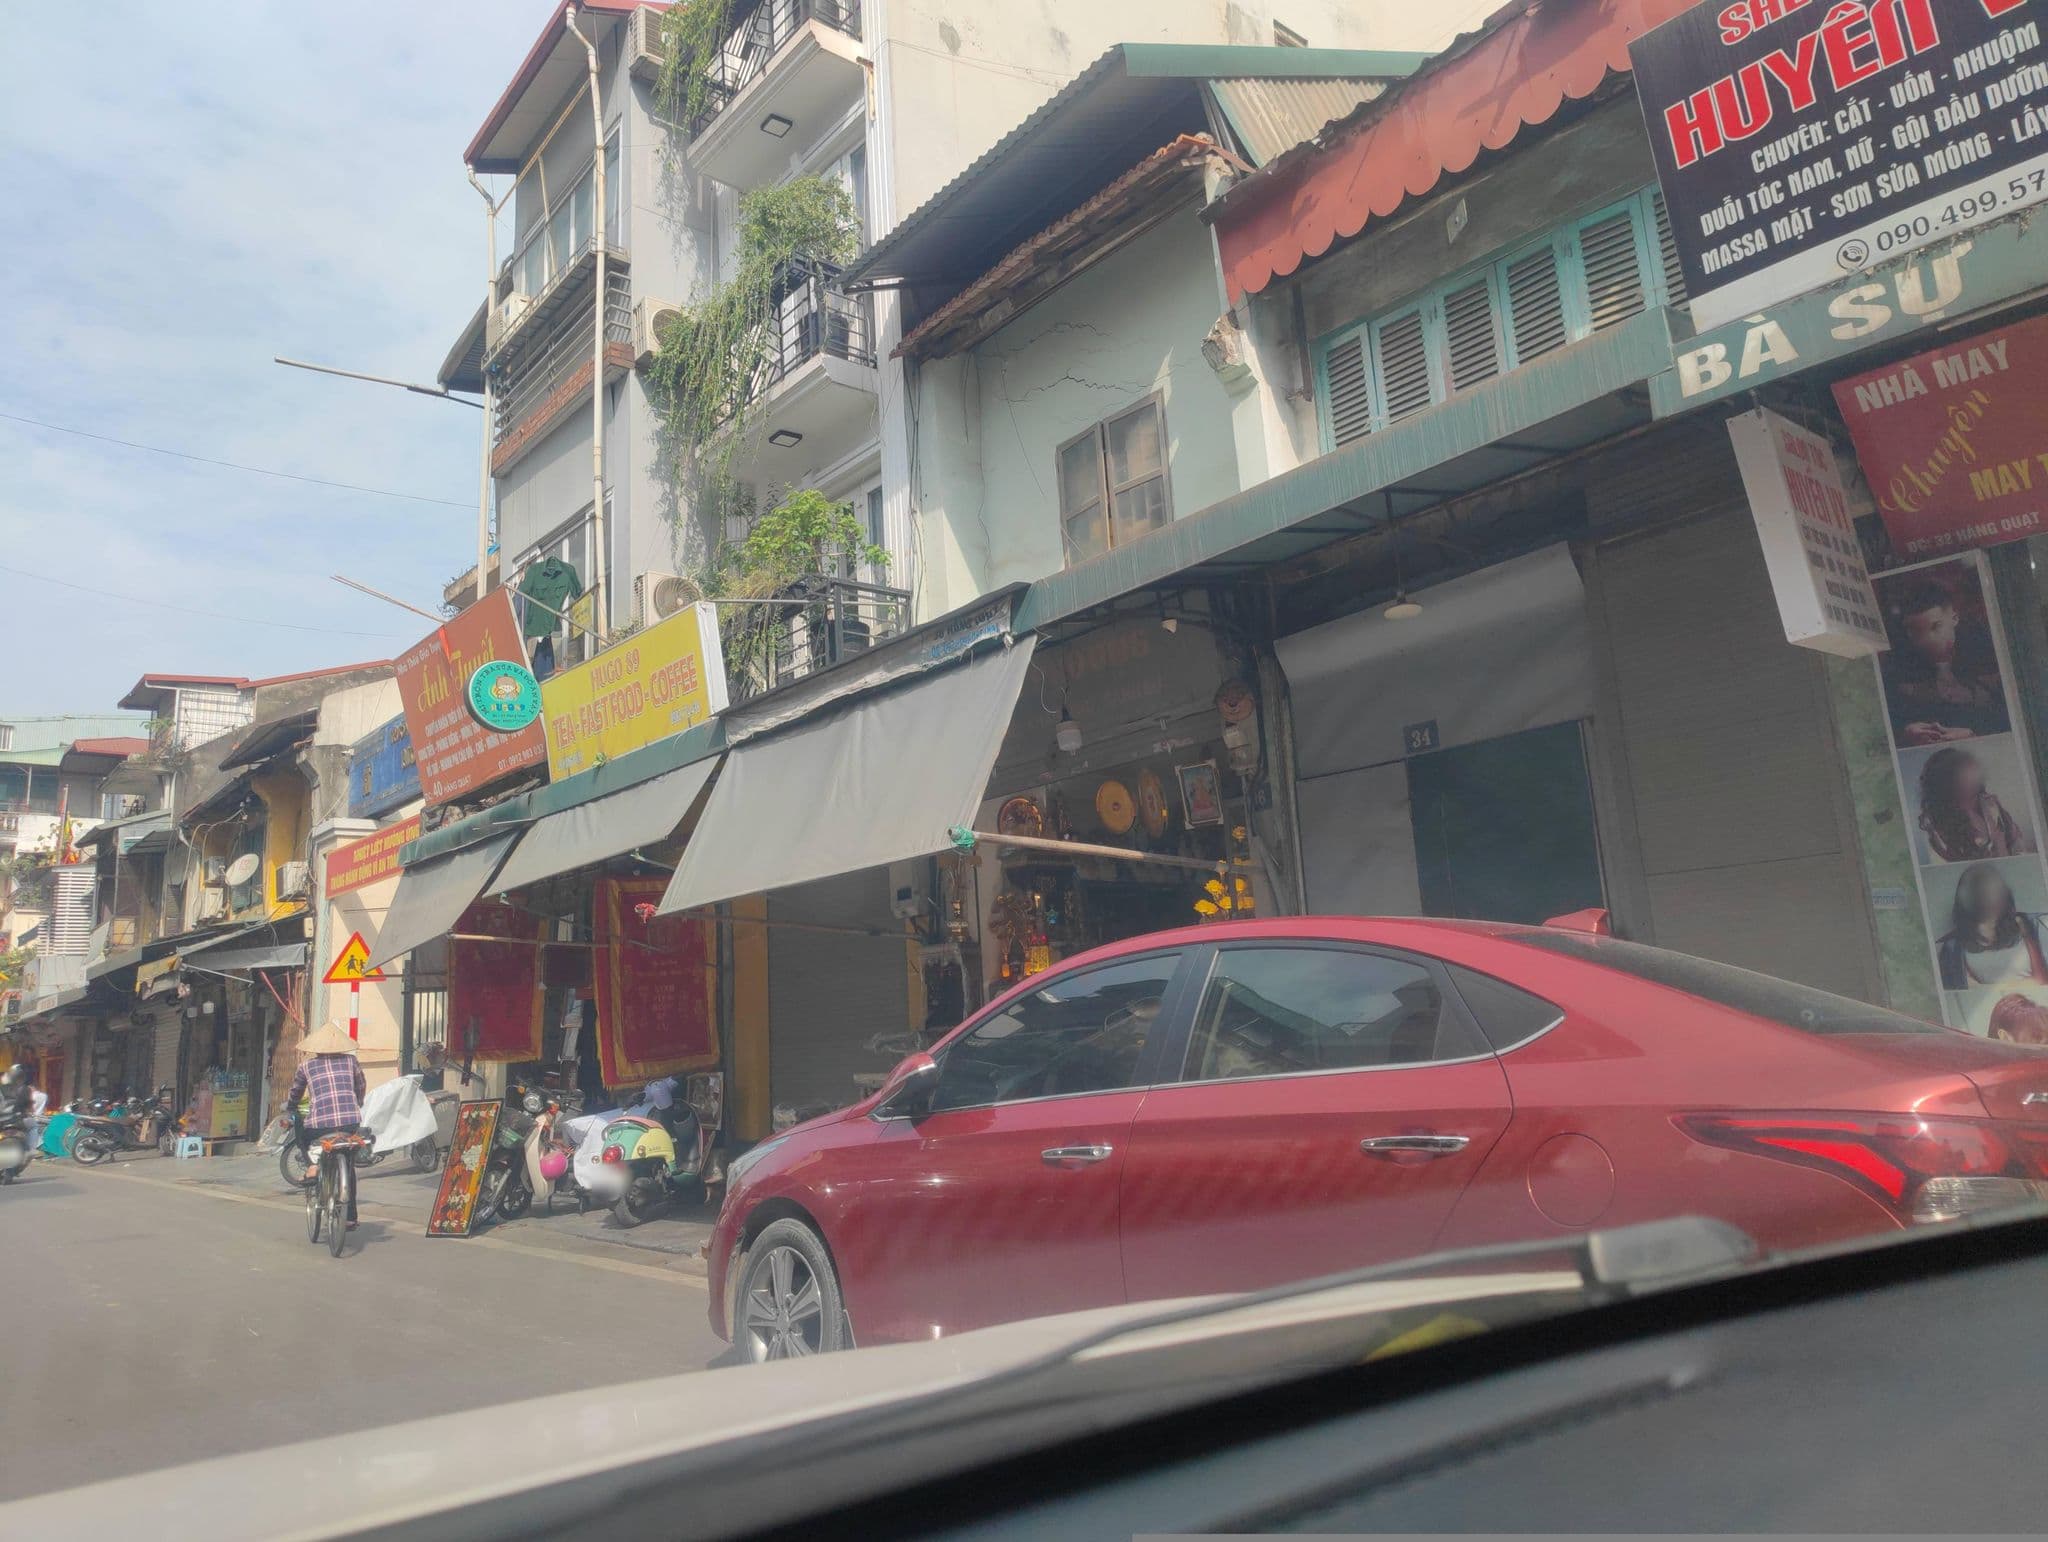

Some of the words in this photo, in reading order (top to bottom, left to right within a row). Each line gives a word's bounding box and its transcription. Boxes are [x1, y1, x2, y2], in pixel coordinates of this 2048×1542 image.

[1751, 121, 1832, 173] CHUYÊN:
[1834, 97, 1872, 134] CẮT
[1890, 70, 1935, 108] UỐN
[1953, 21, 2040, 81] NHUỘM
[1700, 195, 1745, 237] DUỖI
[1747, 182, 1785, 215] TÓC
[1788, 157, 1842, 197] NAM,
[1844, 136, 1875, 171] NỮ
[1892, 115, 1931, 150] GỘI
[1934, 92, 1980, 132] ĐẦU
[1702, 228, 1768, 274] MASSA
[1771, 206, 1813, 244] MẶT
[1831, 182, 1873, 218] SƠN
[1876, 162, 1920, 198] SỬA
[1923, 132, 1992, 180] MÓNG
[1677, 314, 1800, 399] BÀ
[1828, 240, 1973, 340] SỰ
[1854, 364, 1928, 413] NHÀ
[1932, 339, 2009, 389] MAY
[1969, 458, 2032, 501] MAY
[591, 657, 623, 692] HUGO
[433, 781, 443, 797] 40
